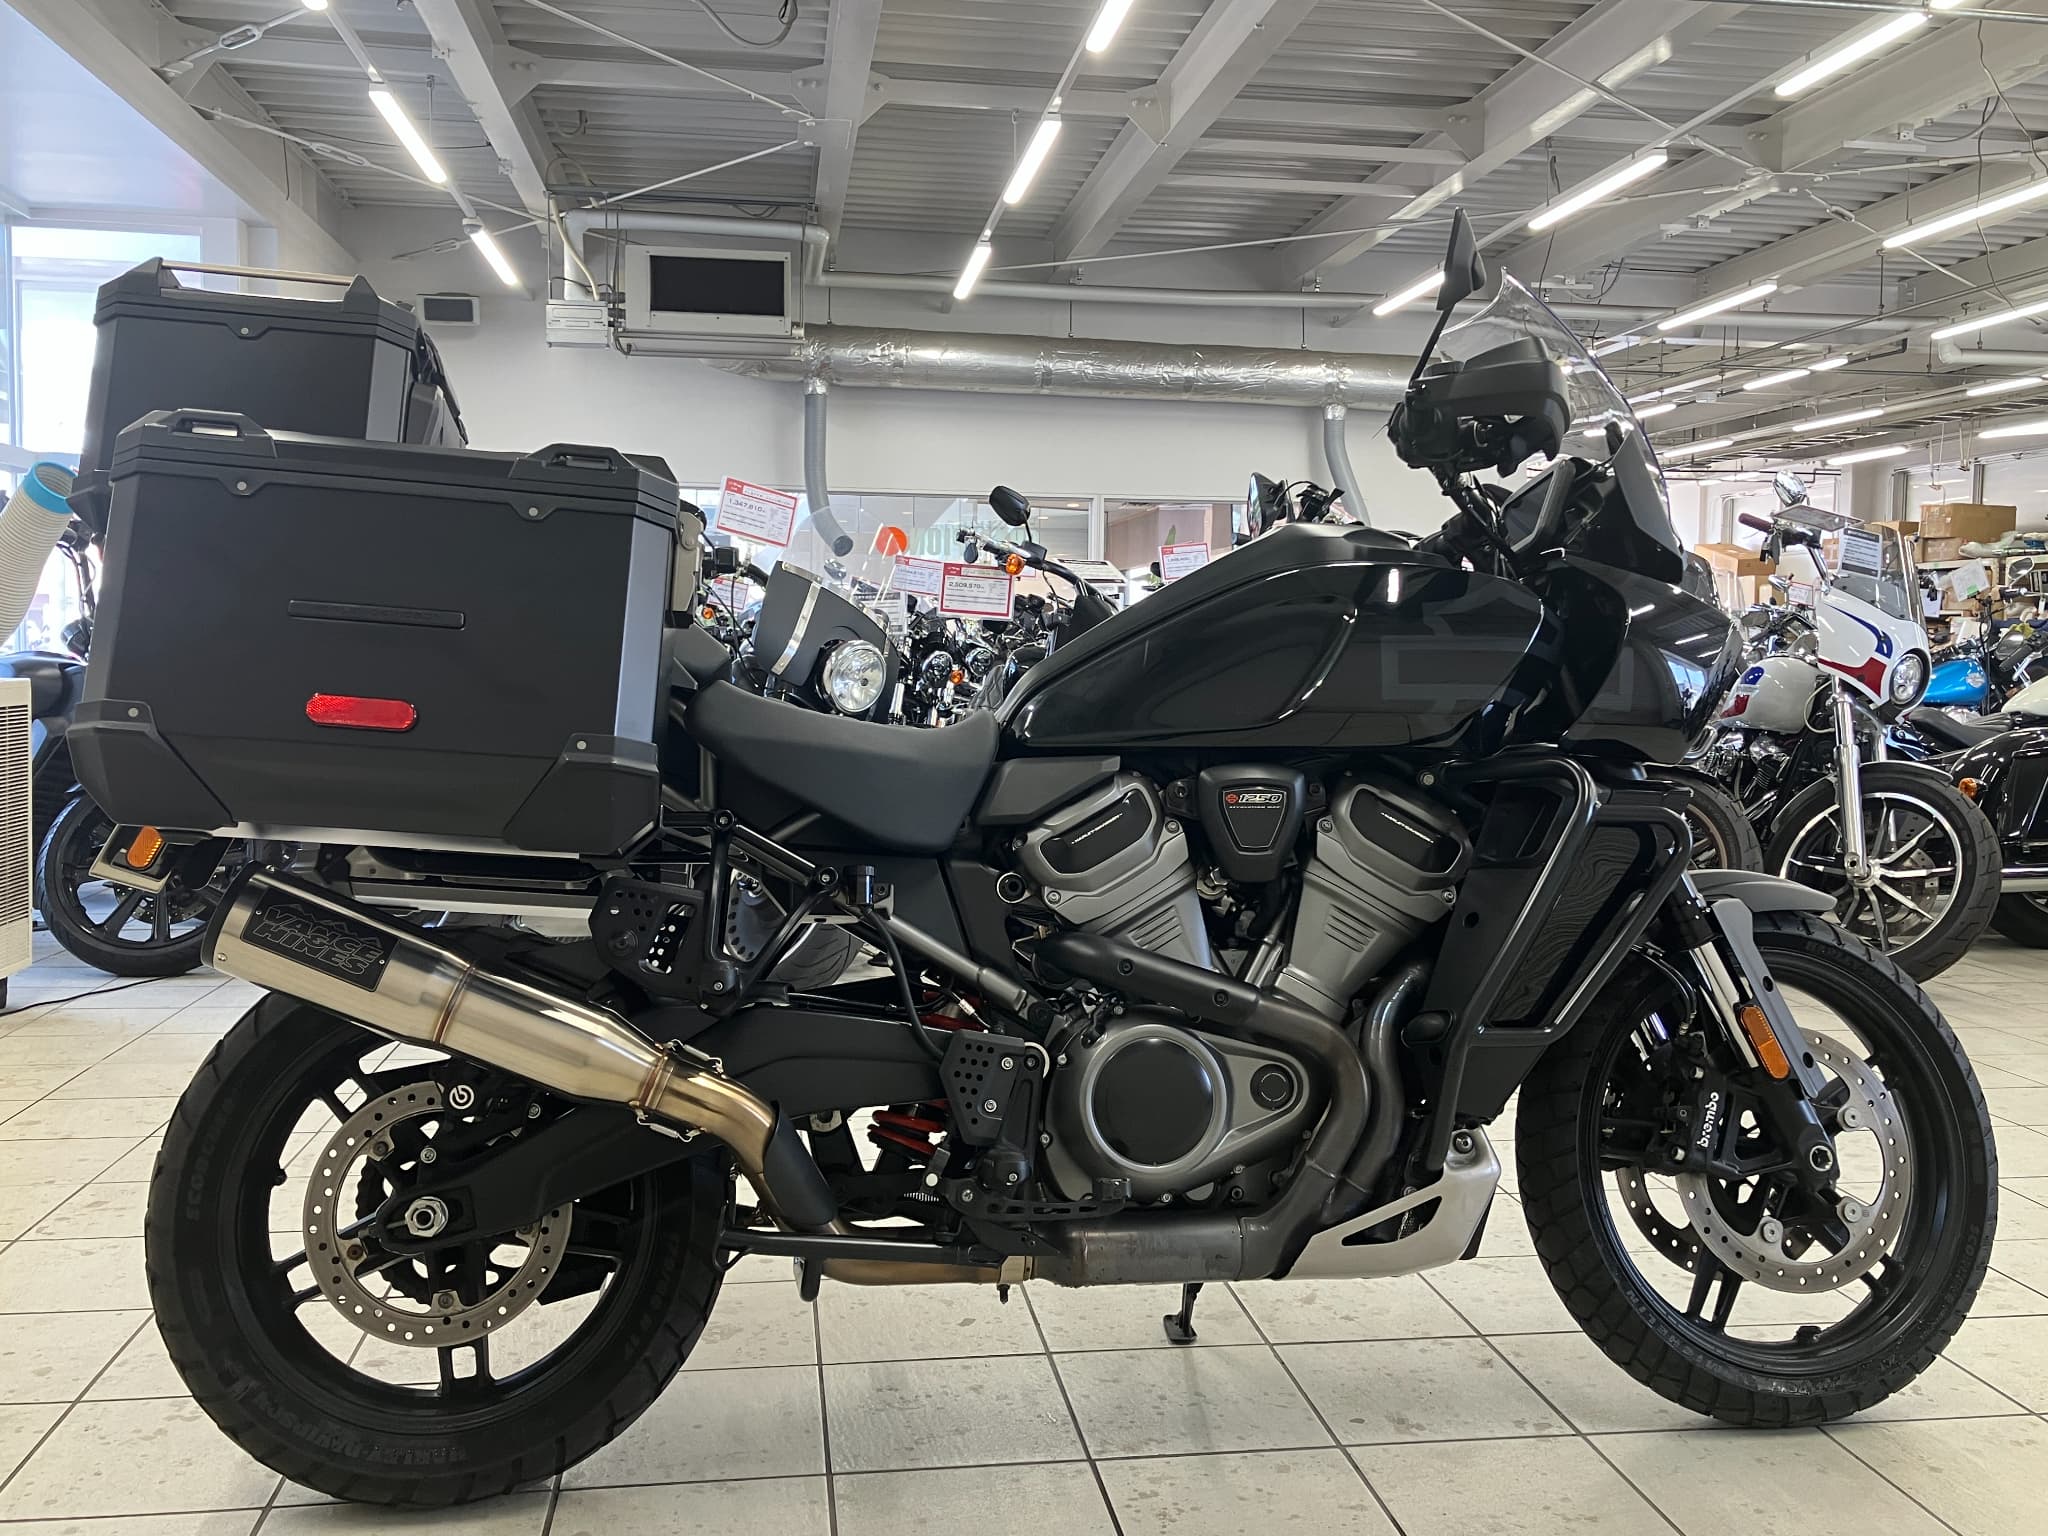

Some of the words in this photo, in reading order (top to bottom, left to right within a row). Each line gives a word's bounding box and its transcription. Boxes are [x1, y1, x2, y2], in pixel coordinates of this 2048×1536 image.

[1238, 793, 1283, 804] 1250
[252, 921, 369, 975] HINES
[263, 906, 384, 963] VANCE
[1696, 1091, 1720, 1148] brembo
